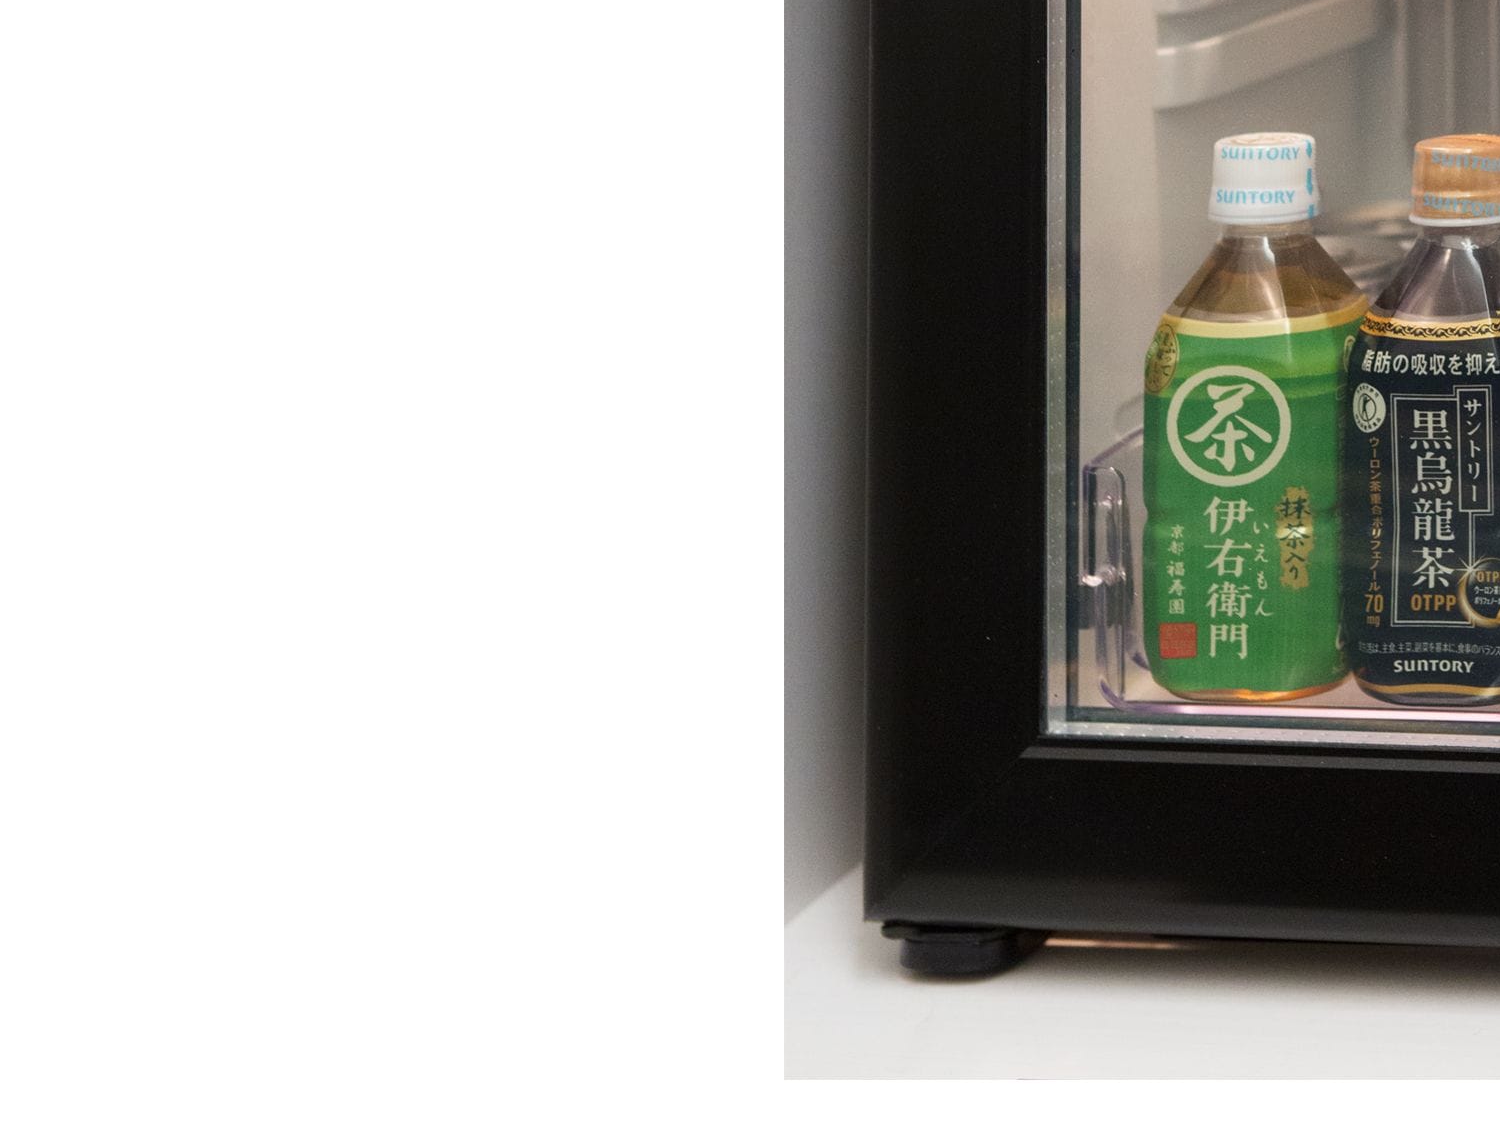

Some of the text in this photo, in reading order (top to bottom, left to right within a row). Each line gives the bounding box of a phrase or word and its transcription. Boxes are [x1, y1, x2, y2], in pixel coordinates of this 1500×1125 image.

[1216, 189, 1295, 204] SUNTORY
[1463, 398, 1483, 503] サントリー
[1279, 497, 1313, 581] 抹茶入り
[1409, 409, 1456, 590] 黒烏龍茶
[1203, 495, 1255, 660] 伊右衛門
[1252, 520, 1274, 617] いえもん
[1410, 593, 1458, 613] OTPP
[1393, 659, 1475, 673] SUNTORY
